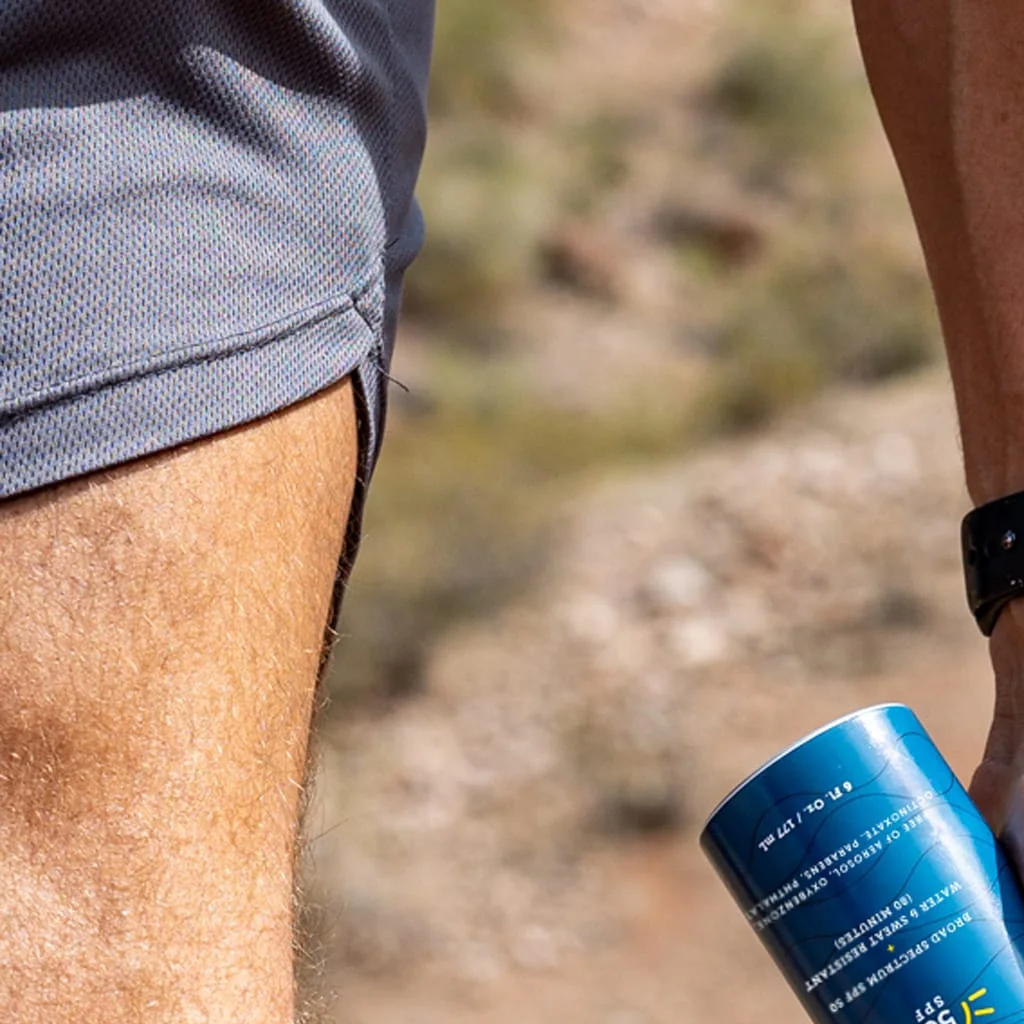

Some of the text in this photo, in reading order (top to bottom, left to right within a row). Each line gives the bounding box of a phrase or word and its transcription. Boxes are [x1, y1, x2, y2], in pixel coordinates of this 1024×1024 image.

[843, 781, 854, 793] 6
[796, 812, 803, 824] /
[803, 799, 825, 814] Oz.
[776, 819, 796, 840] 177
[885, 830, 901, 845] OF
[758, 834, 776, 852] mL
[919, 881, 963, 912] WATER
[834, 906, 893, 950] MINUTES)
[869, 914, 910, 948] SWEAT
[804, 944, 869, 993] RESISTANT
[828, 911, 973, 1014] BROAD SPECTRUM SPF 50
[914, 995, 946, 1023] SPF
